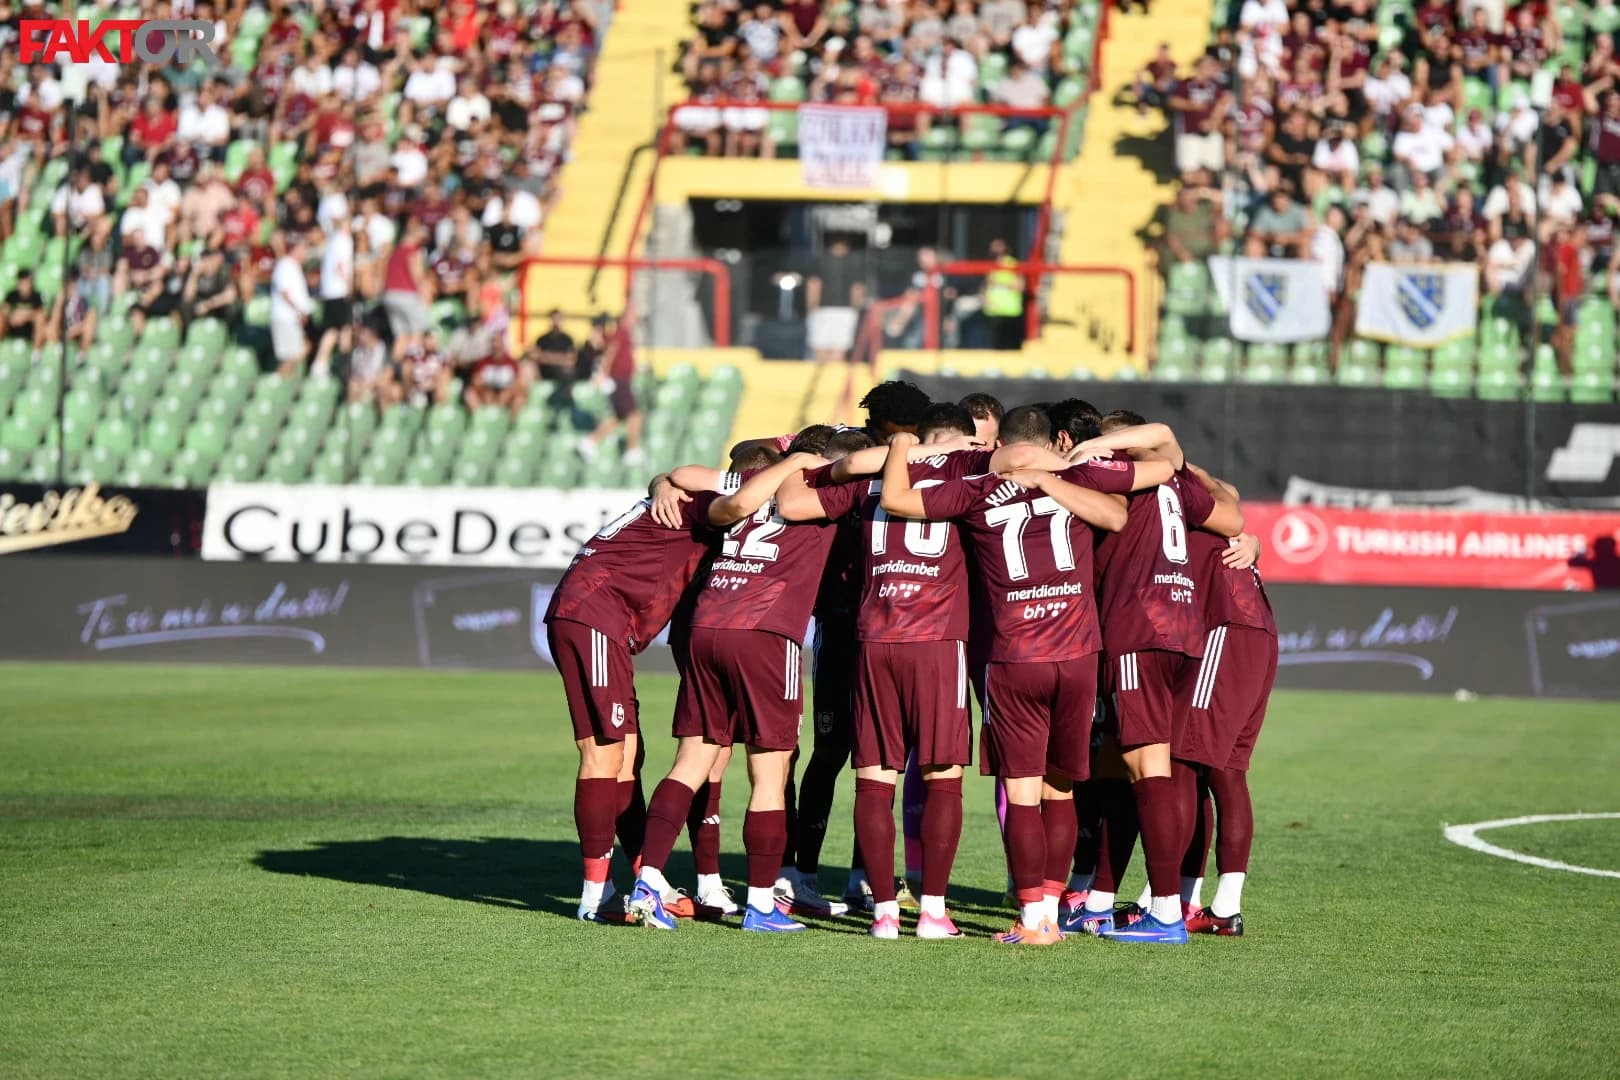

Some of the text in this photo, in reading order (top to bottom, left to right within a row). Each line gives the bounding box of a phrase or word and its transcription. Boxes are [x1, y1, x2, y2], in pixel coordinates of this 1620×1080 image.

[1157, 484, 1189, 565] 6
[984, 496, 1076, 581] 77
[1334, 526, 1587, 560] TURKISH AIRLINES
[872, 560, 940, 577] meridianbet
[878, 583, 898, 598] bh
[1006, 582, 1082, 602] meridianbet
[1023, 603, 1046, 619] bh
